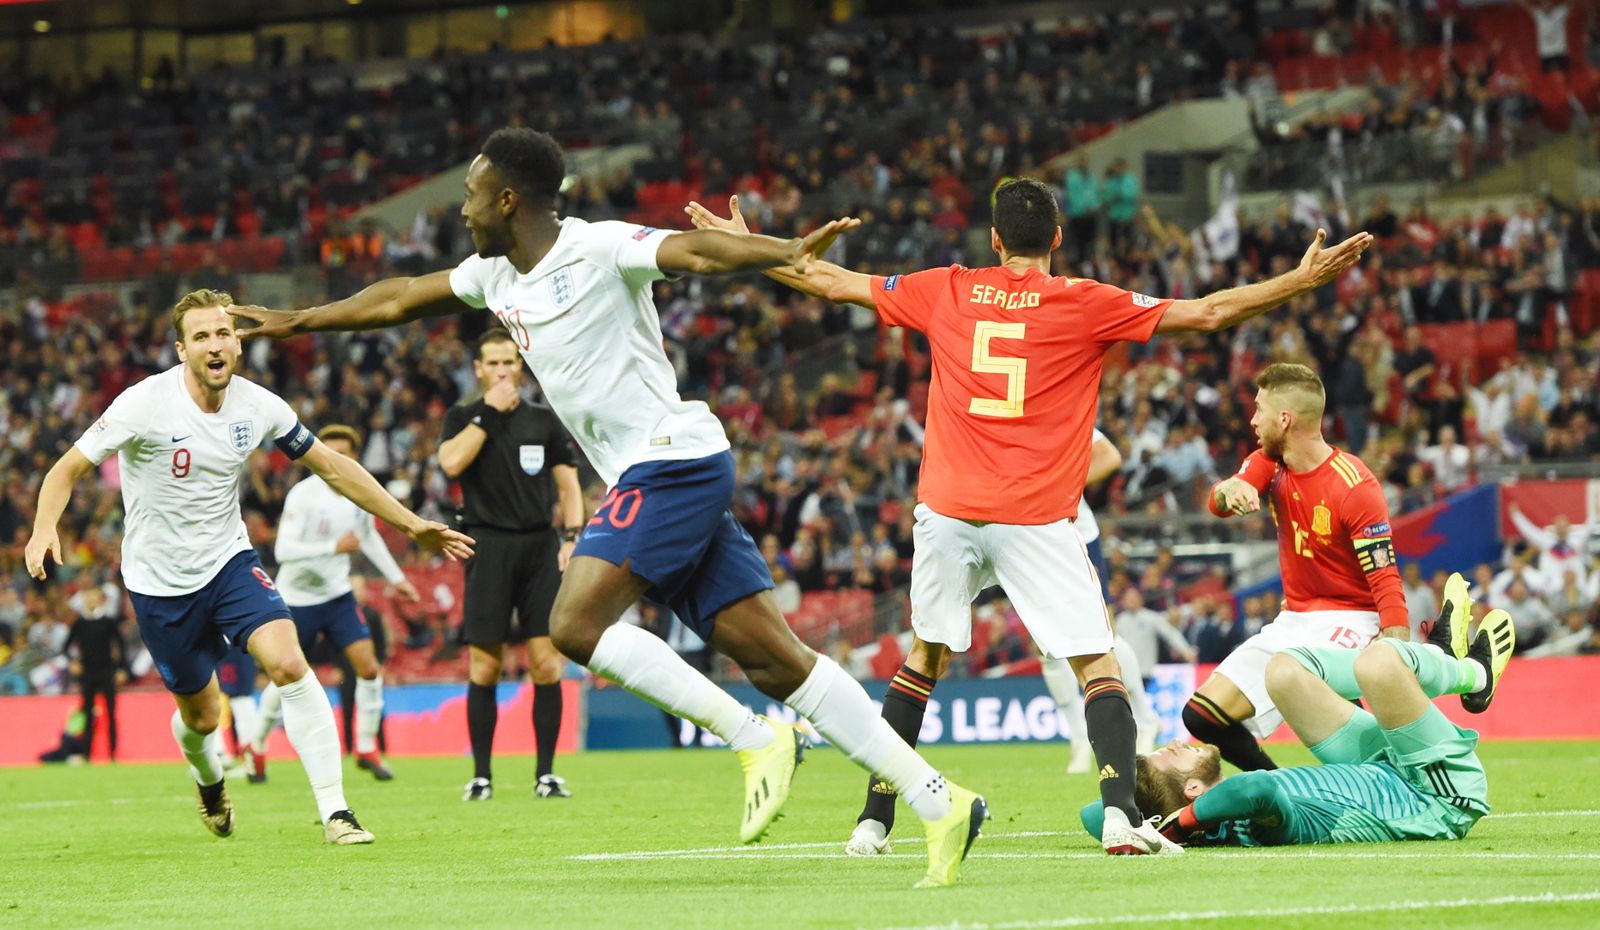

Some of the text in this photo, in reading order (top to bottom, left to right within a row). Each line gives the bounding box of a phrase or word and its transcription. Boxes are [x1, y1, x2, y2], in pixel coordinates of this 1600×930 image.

[969, 283, 1041, 310] SERGIO
[968, 320, 1027, 418] 5
[171, 448, 192, 478] 9
[251, 565, 277, 591] 9
[1330, 626, 1361, 649] 15
